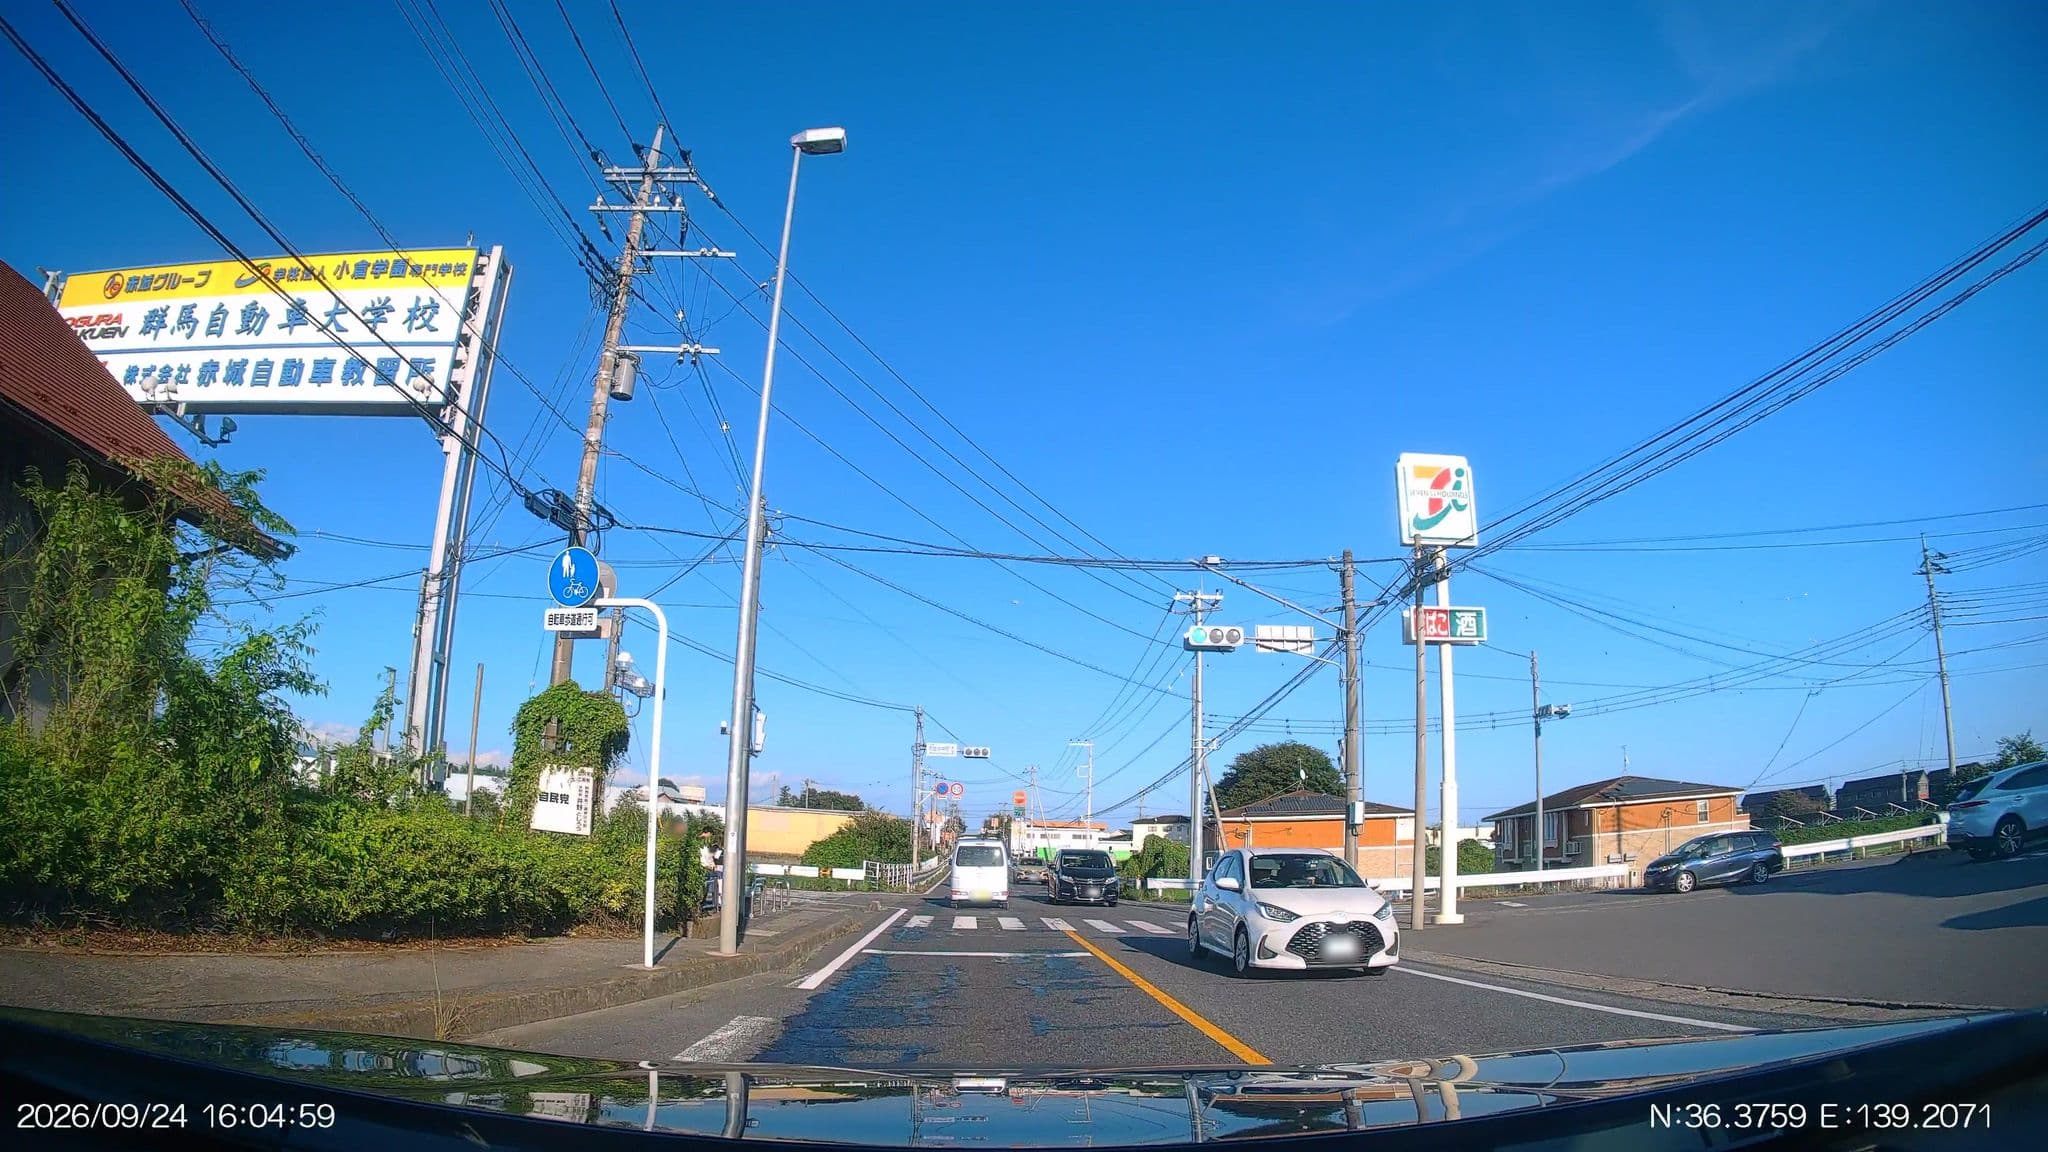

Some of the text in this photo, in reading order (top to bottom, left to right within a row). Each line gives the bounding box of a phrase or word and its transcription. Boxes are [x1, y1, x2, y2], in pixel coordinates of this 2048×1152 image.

[139, 296, 440, 341] 群馬自動車大学校
[123, 362, 191, 386] 株式会社
[1455, 611, 1477, 636] 酒
[538, 791, 570, 805] 自民党
